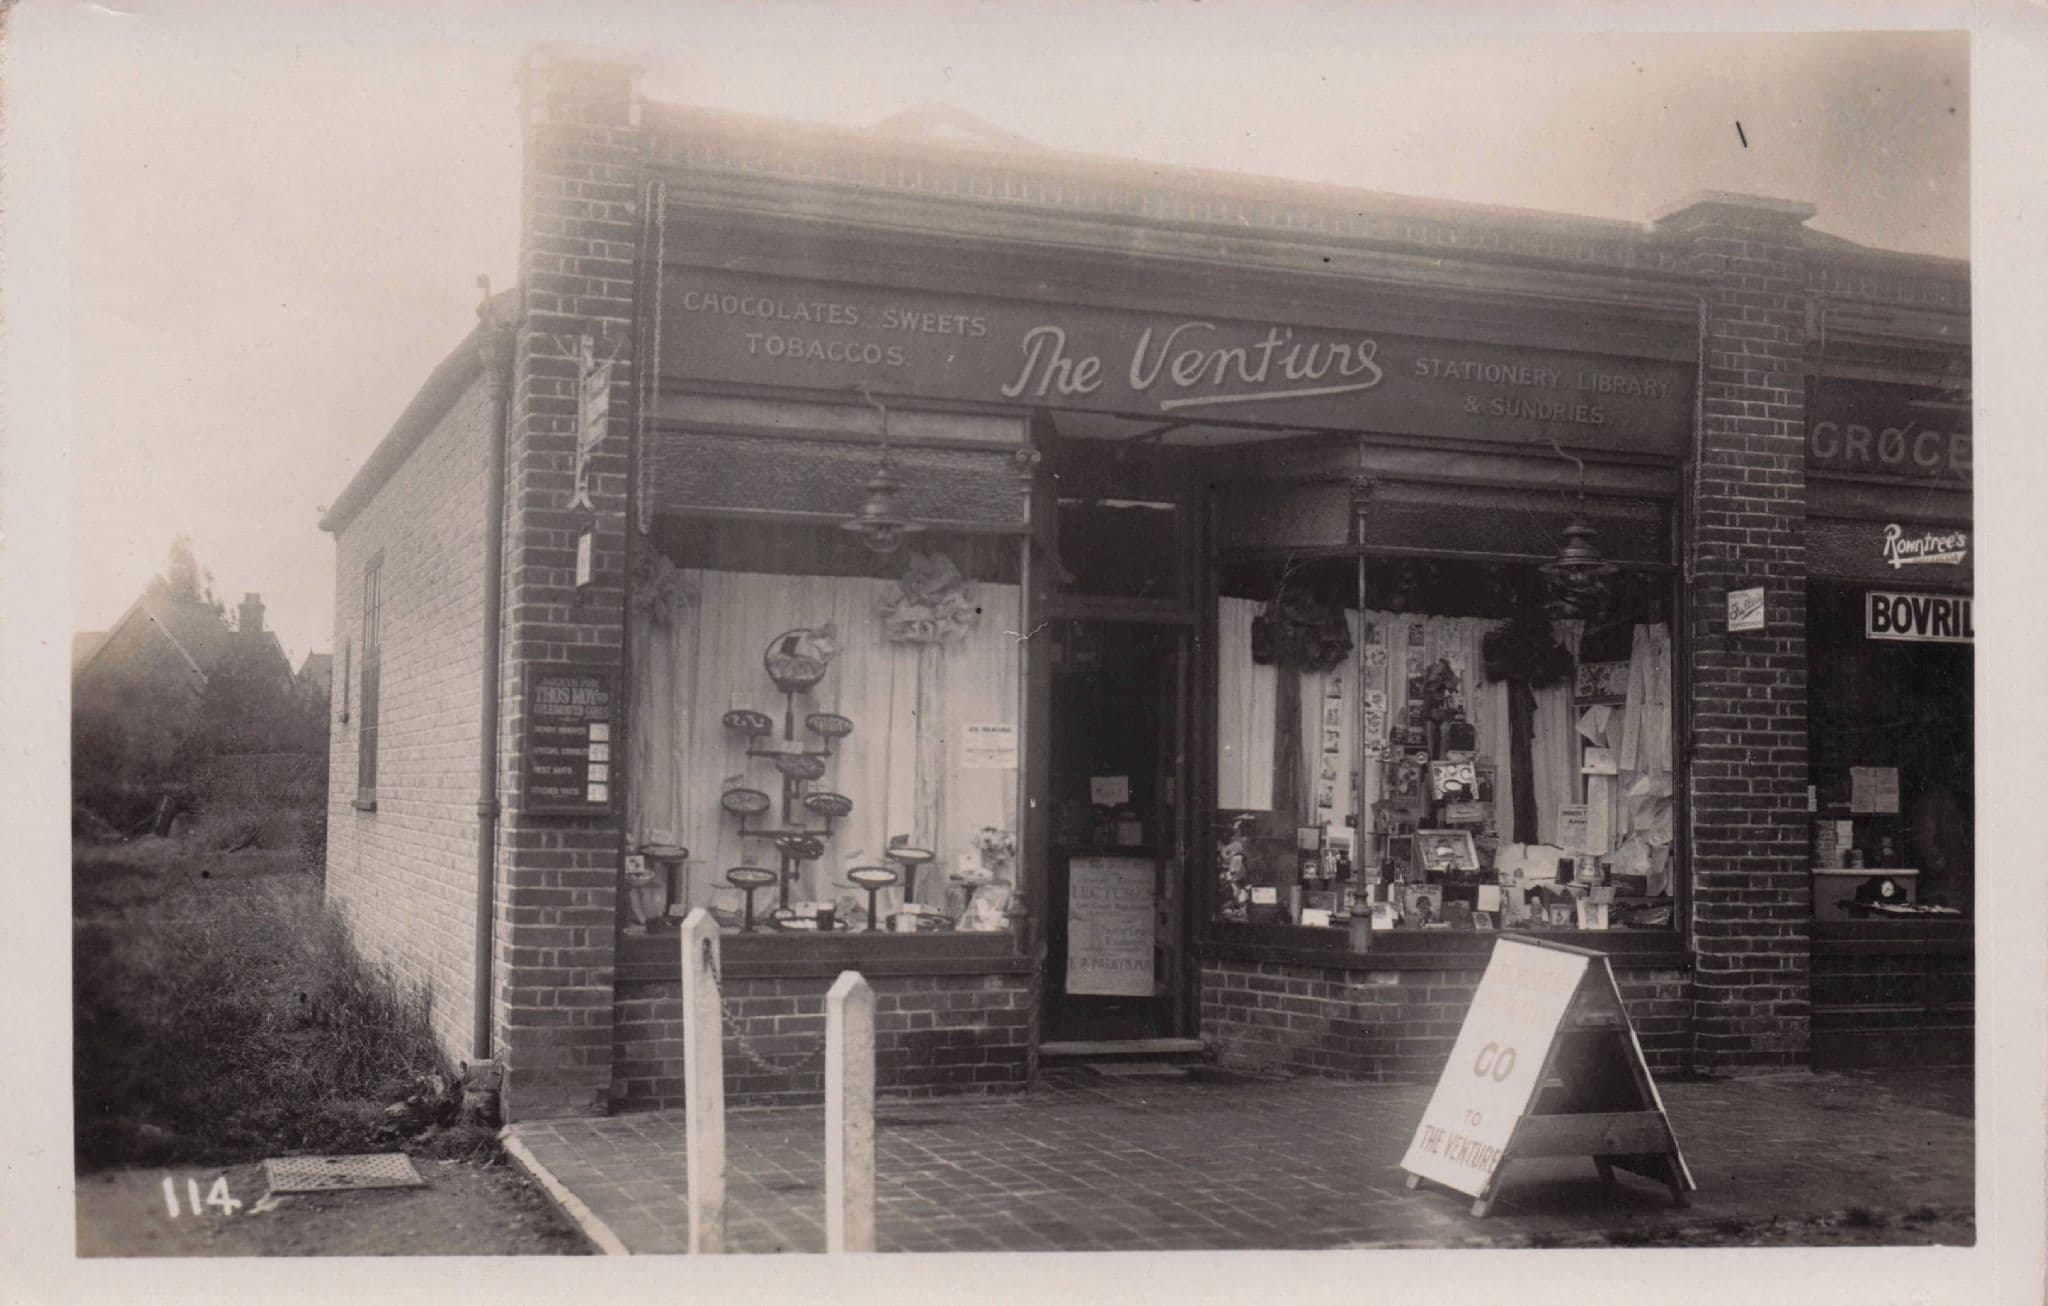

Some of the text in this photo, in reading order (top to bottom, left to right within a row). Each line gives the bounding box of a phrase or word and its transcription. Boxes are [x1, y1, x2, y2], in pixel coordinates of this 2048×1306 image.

[682, 291, 988, 338] CHOCOLATES SWEETS
[744, 332, 905, 367] TOBACCOS
[1001, 325, 1103, 398] The
[1414, 357, 1669, 399] STATIONERY LIBRARY
[1463, 394, 1605, 425] & SUNDRIES
[1883, 523, 1968, 569] Rowntree's
[1871, 594, 1975, 637] BOVRIL
[1473, 1042, 1516, 1082] GO
[1465, 1109, 1482, 1127] TO
[1420, 1124, 1502, 1174] THE VENTURE
